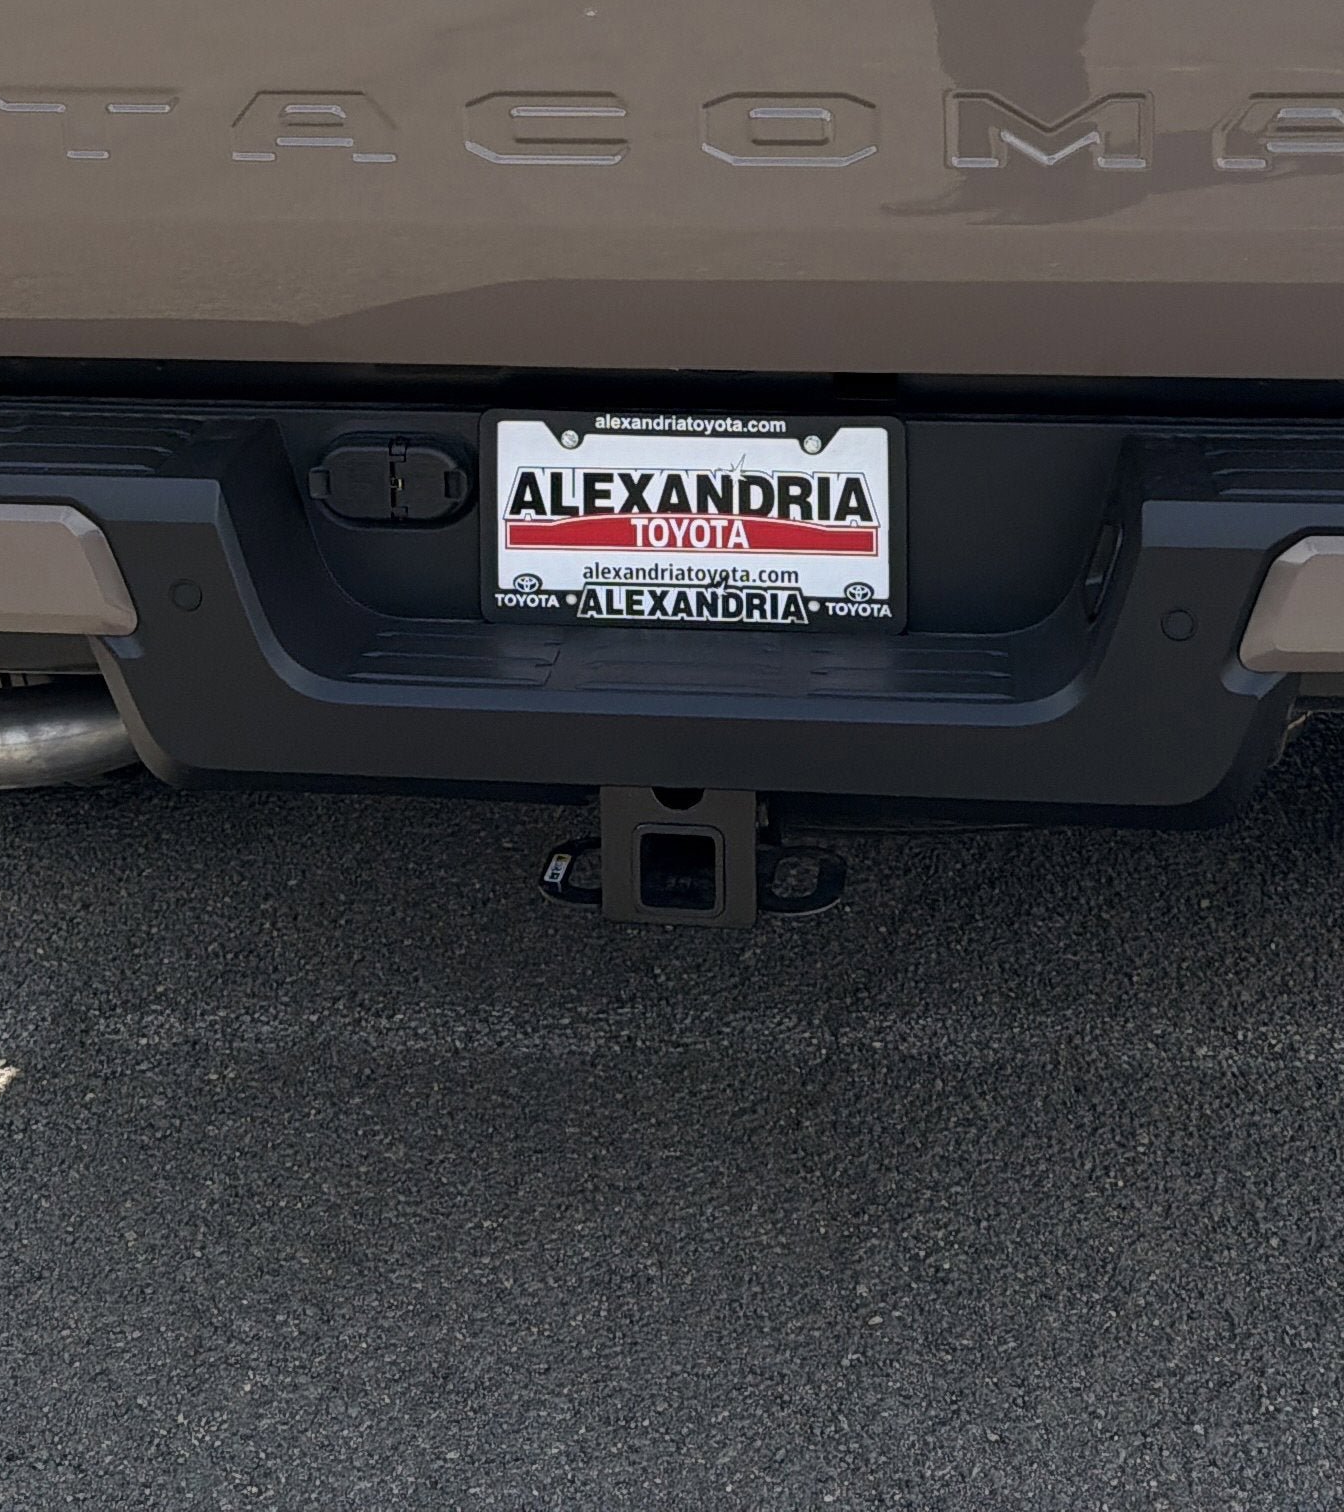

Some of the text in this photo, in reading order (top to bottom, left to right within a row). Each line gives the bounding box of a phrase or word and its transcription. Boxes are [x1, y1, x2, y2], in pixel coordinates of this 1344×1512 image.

[594, 413, 787, 434] alexandriatoyota.com
[508, 470, 875, 523] ALEXANDRIA
[629, 517, 750, 550] TOYOTA
[582, 563, 799, 585] alexandriatoyota.com
[494, 586, 893, 624] TOYOTA ALEXANDRIA TOYOTA
